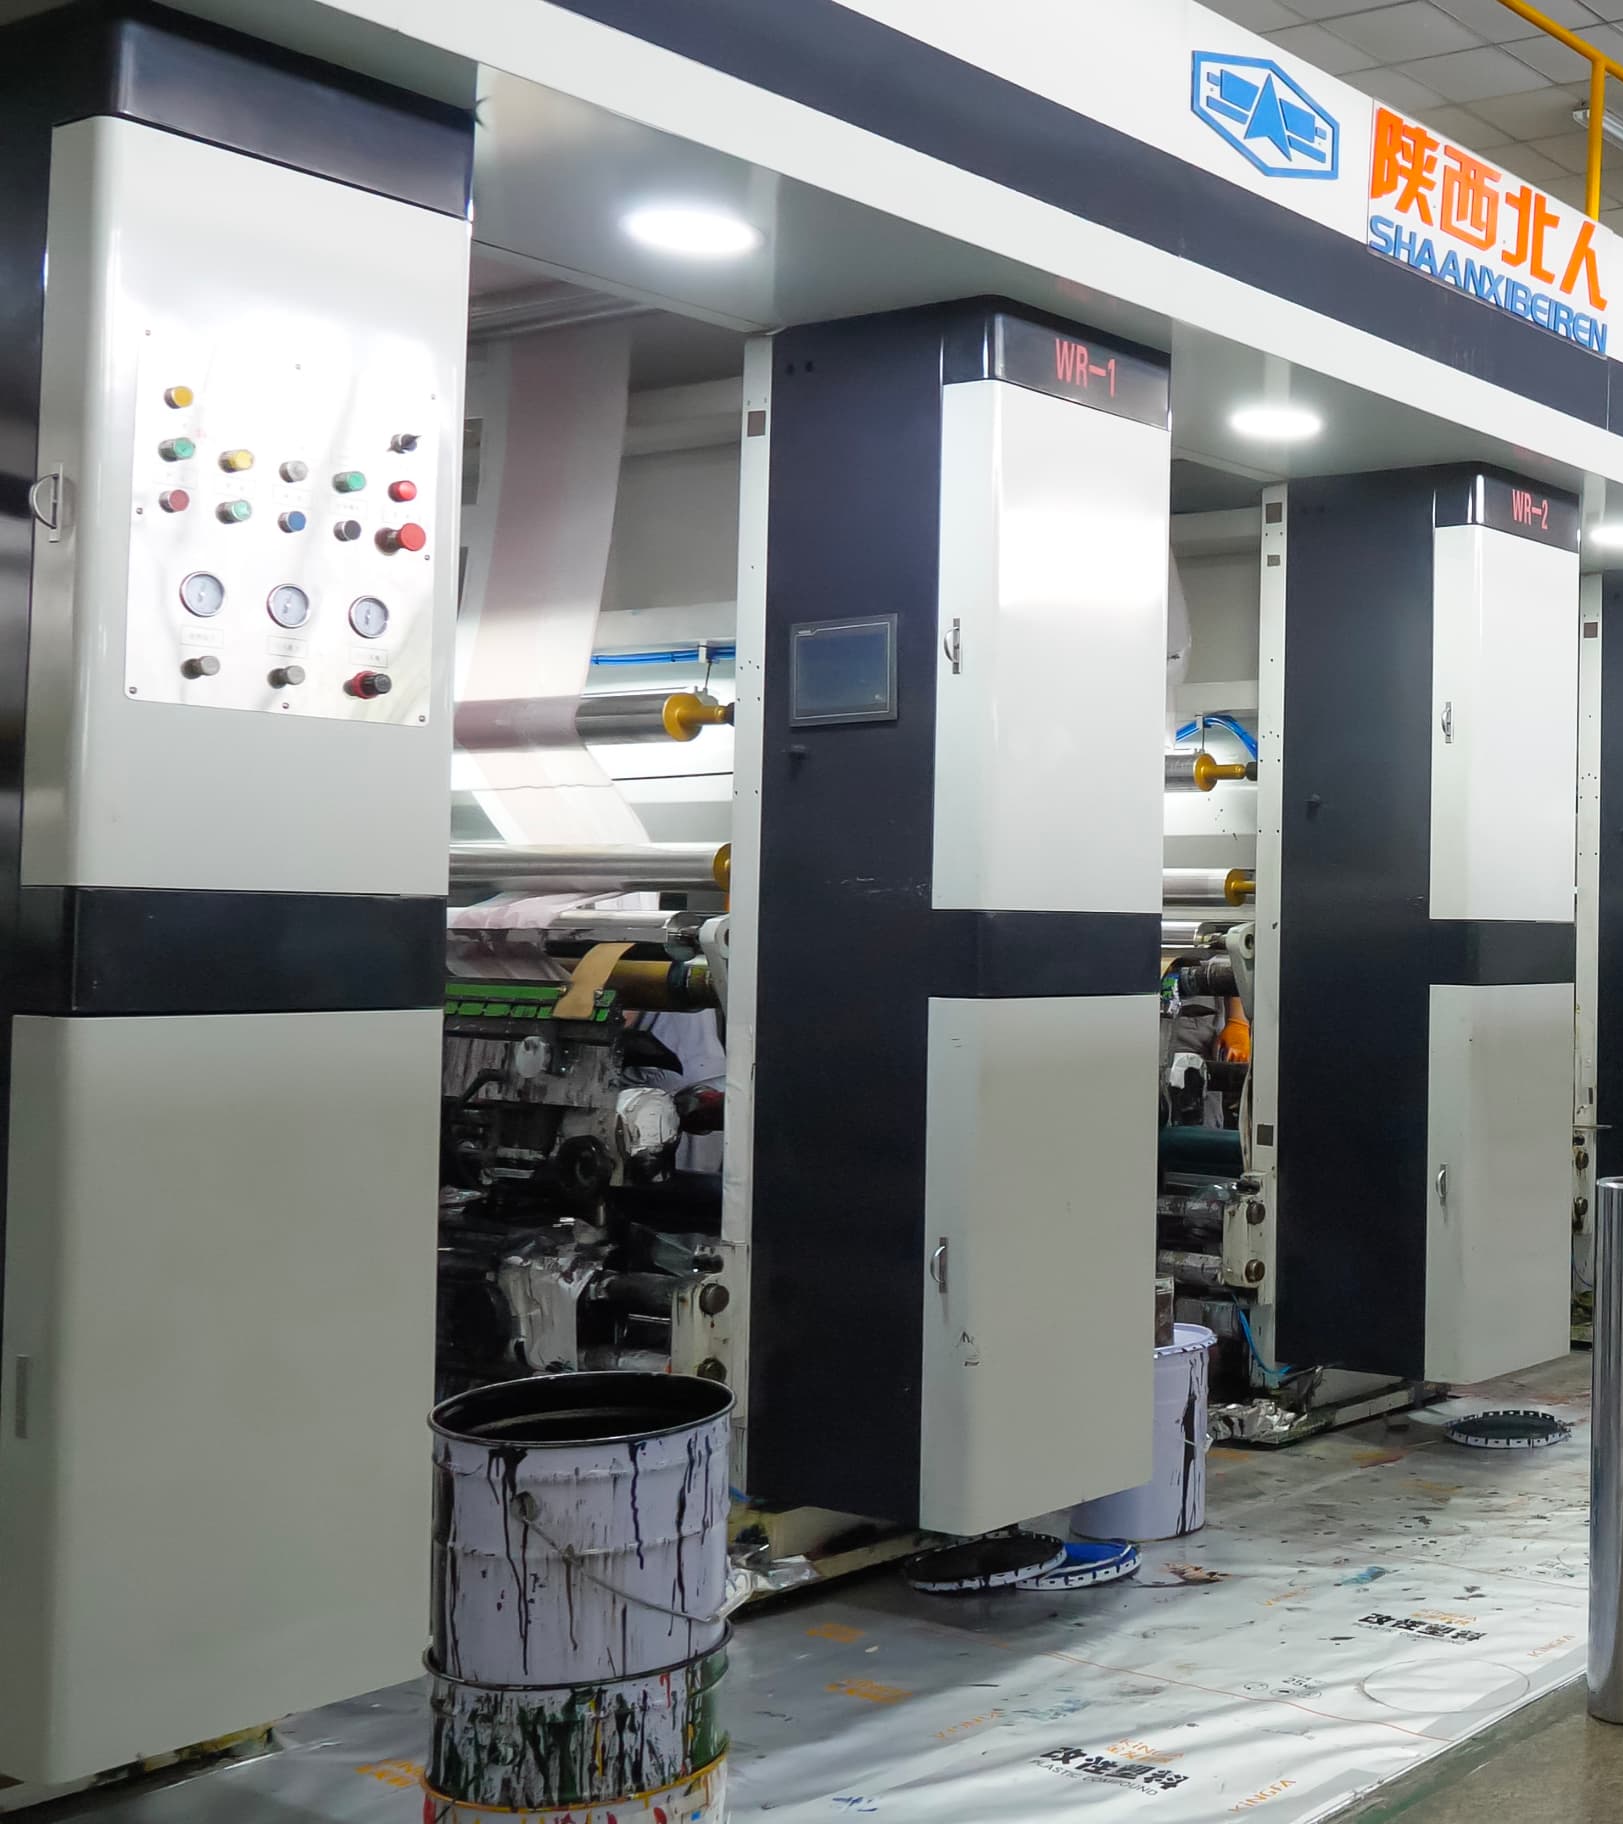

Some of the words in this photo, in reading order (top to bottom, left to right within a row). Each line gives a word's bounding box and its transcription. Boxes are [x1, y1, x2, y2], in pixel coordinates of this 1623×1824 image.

[1371, 106, 1608, 313] 陕西北人
[1368, 214, 1608, 358] SHAANXIBEIREN
[1055, 337, 1117, 399] WR-1
[1512, 488, 1549, 531] WR-2
